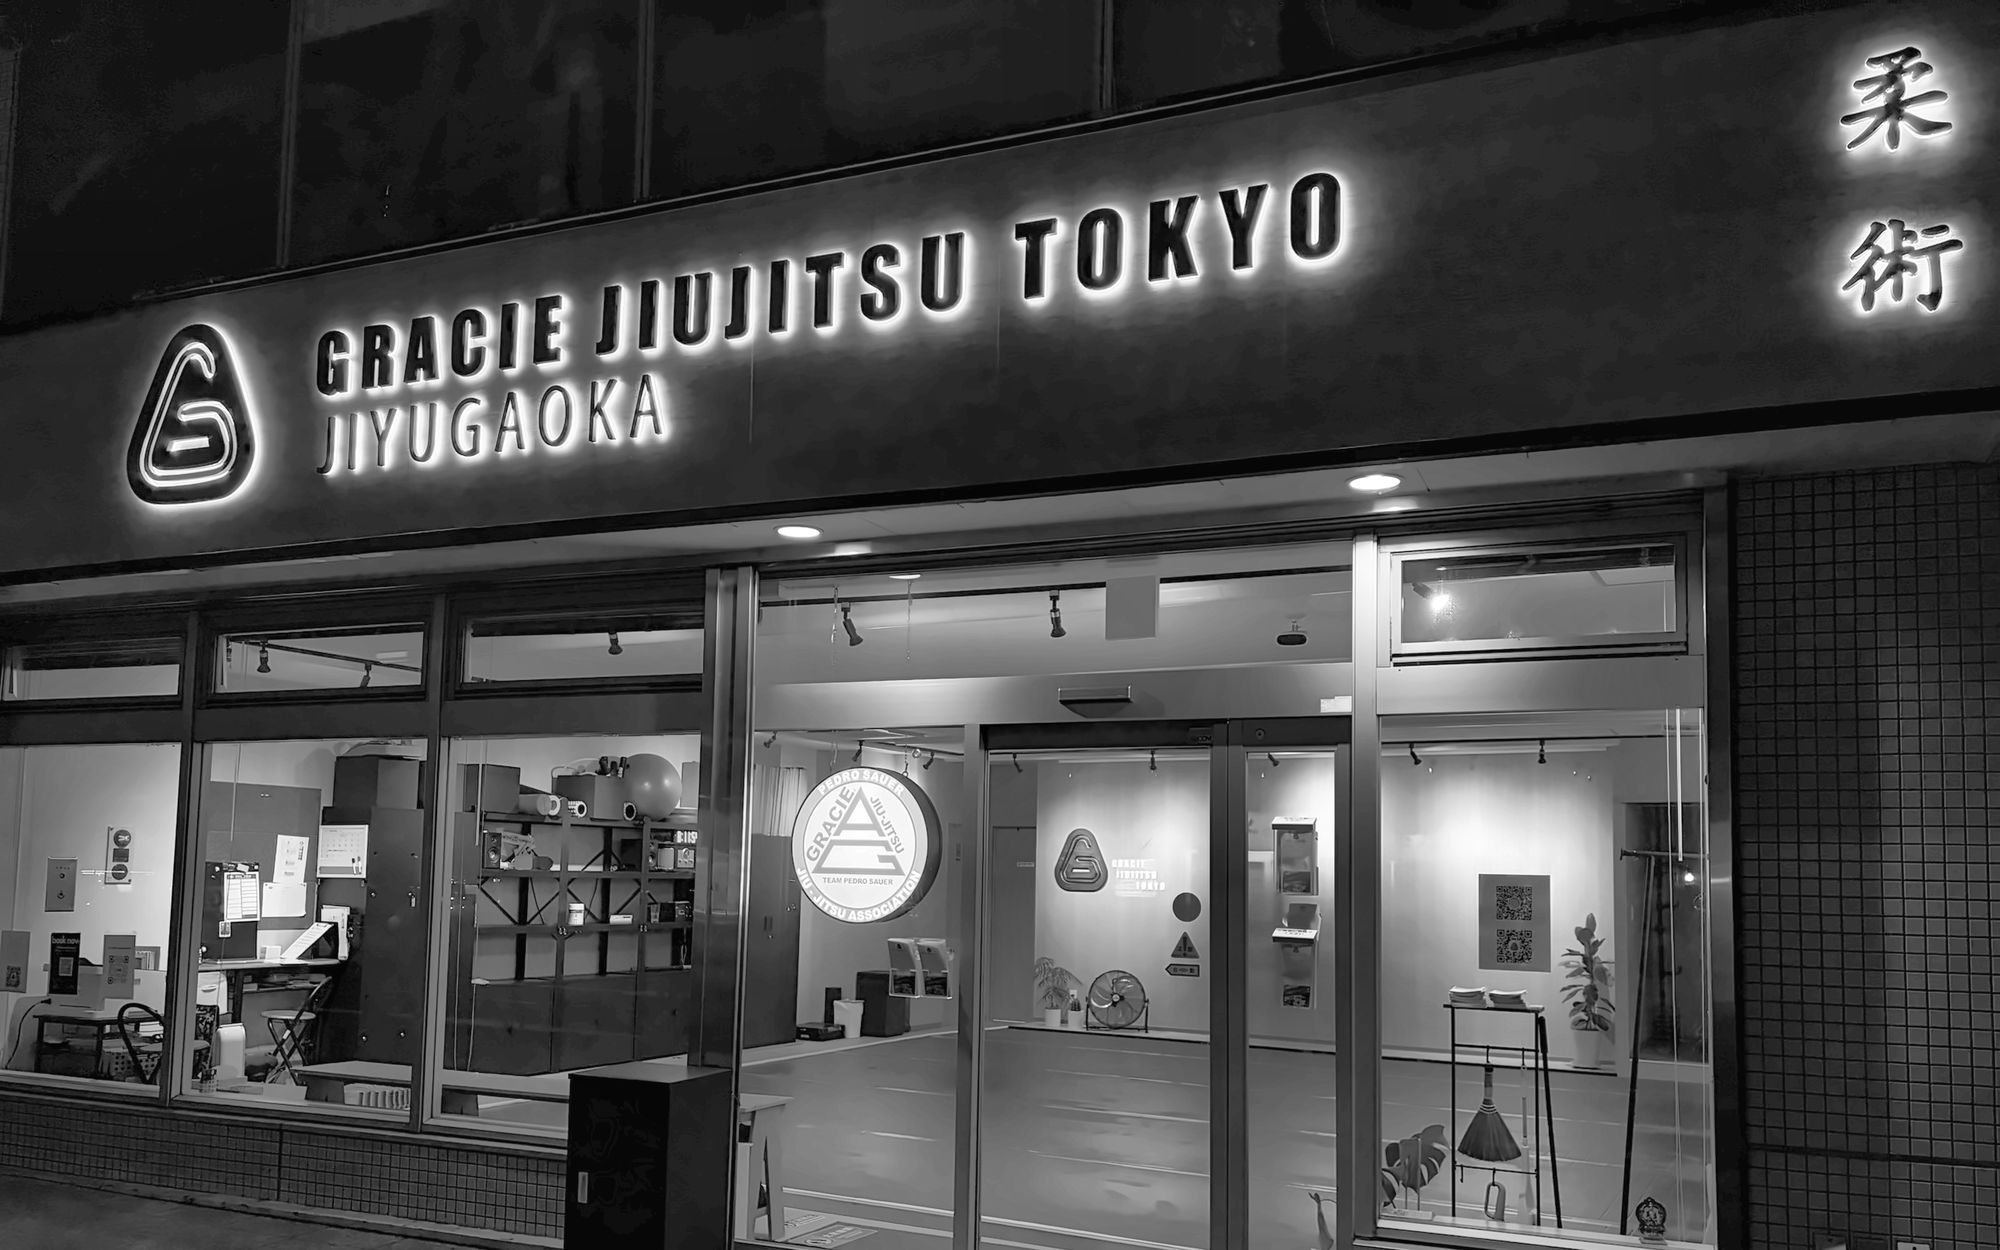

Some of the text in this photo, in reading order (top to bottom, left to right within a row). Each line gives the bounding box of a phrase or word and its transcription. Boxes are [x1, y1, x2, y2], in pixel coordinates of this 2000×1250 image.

[1841, 46, 1963, 311] 柔術
[316, 172, 1342, 396] GRACIE JIUJITSU TOKYO
[316, 373, 663, 475] JIYUGAOKA
[817, 770, 905, 796] PEDRO SAUER
[806, 786, 855, 862] GRACIE
[870, 796, 905, 855] JIU-JITSU
[844, 877, 868, 885] PEDRO
[869, 878, 893, 886] SAUER
[848, 870, 921, 921] ASSOCIATION
